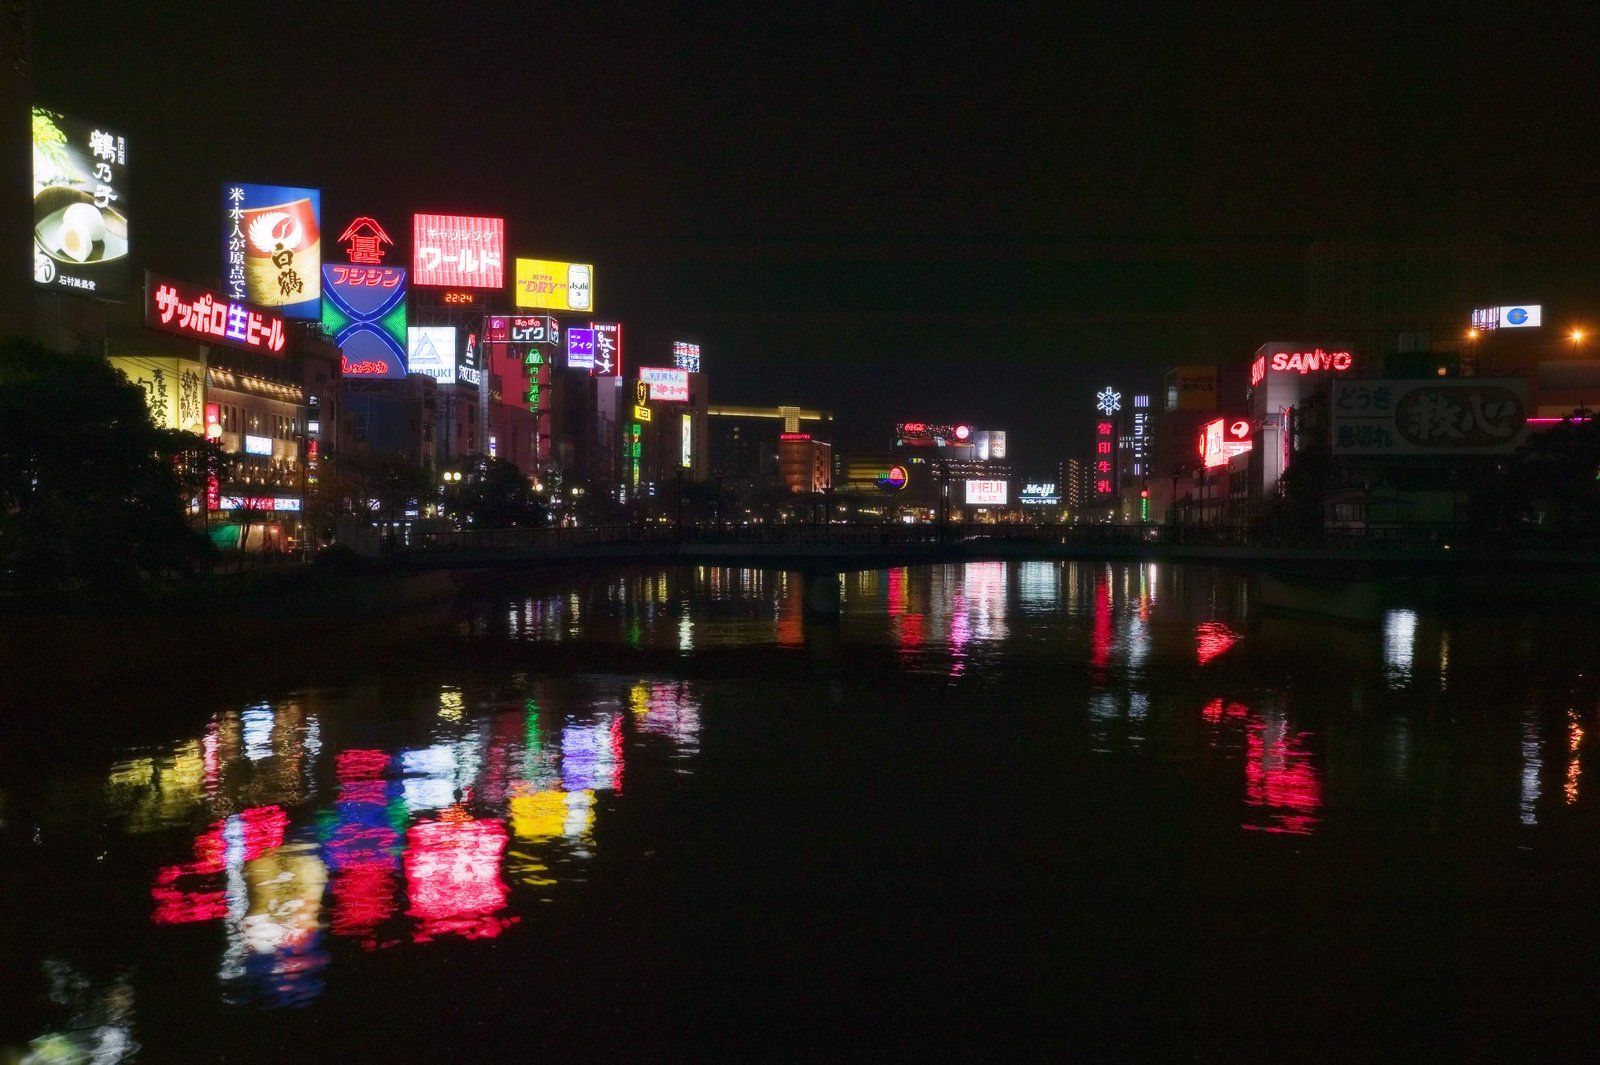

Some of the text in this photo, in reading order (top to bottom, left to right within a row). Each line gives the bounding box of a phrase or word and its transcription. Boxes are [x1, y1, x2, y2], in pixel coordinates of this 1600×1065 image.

[89, 129, 117, 208] 鶴乃子
[427, 230, 493, 242] キャッシング
[272, 242, 303, 297] 白鶴
[420, 248, 500, 273] ワールド
[333, 267, 400, 288] フジジン
[569, 281, 589, 290] Asahi
[446, 293, 472, 303] 22:24
[156, 284, 285, 352] サッポロ生ビール
[512, 326, 544, 340] レイク
[570, 341, 593, 349] アイク
[341, 356, 389, 374] しょうゆ
[1271, 348, 1352, 374] SANYO
[1338, 386, 1391, 411] どうき
[1407, 393, 1517, 440] 救心
[1338, 424, 1392, 448] 息切れ
[1097, 422, 1112, 493] 雪印牛乳
[970, 482, 1003, 494] MEIJI
[1022, 483, 1055, 497] Meiji
